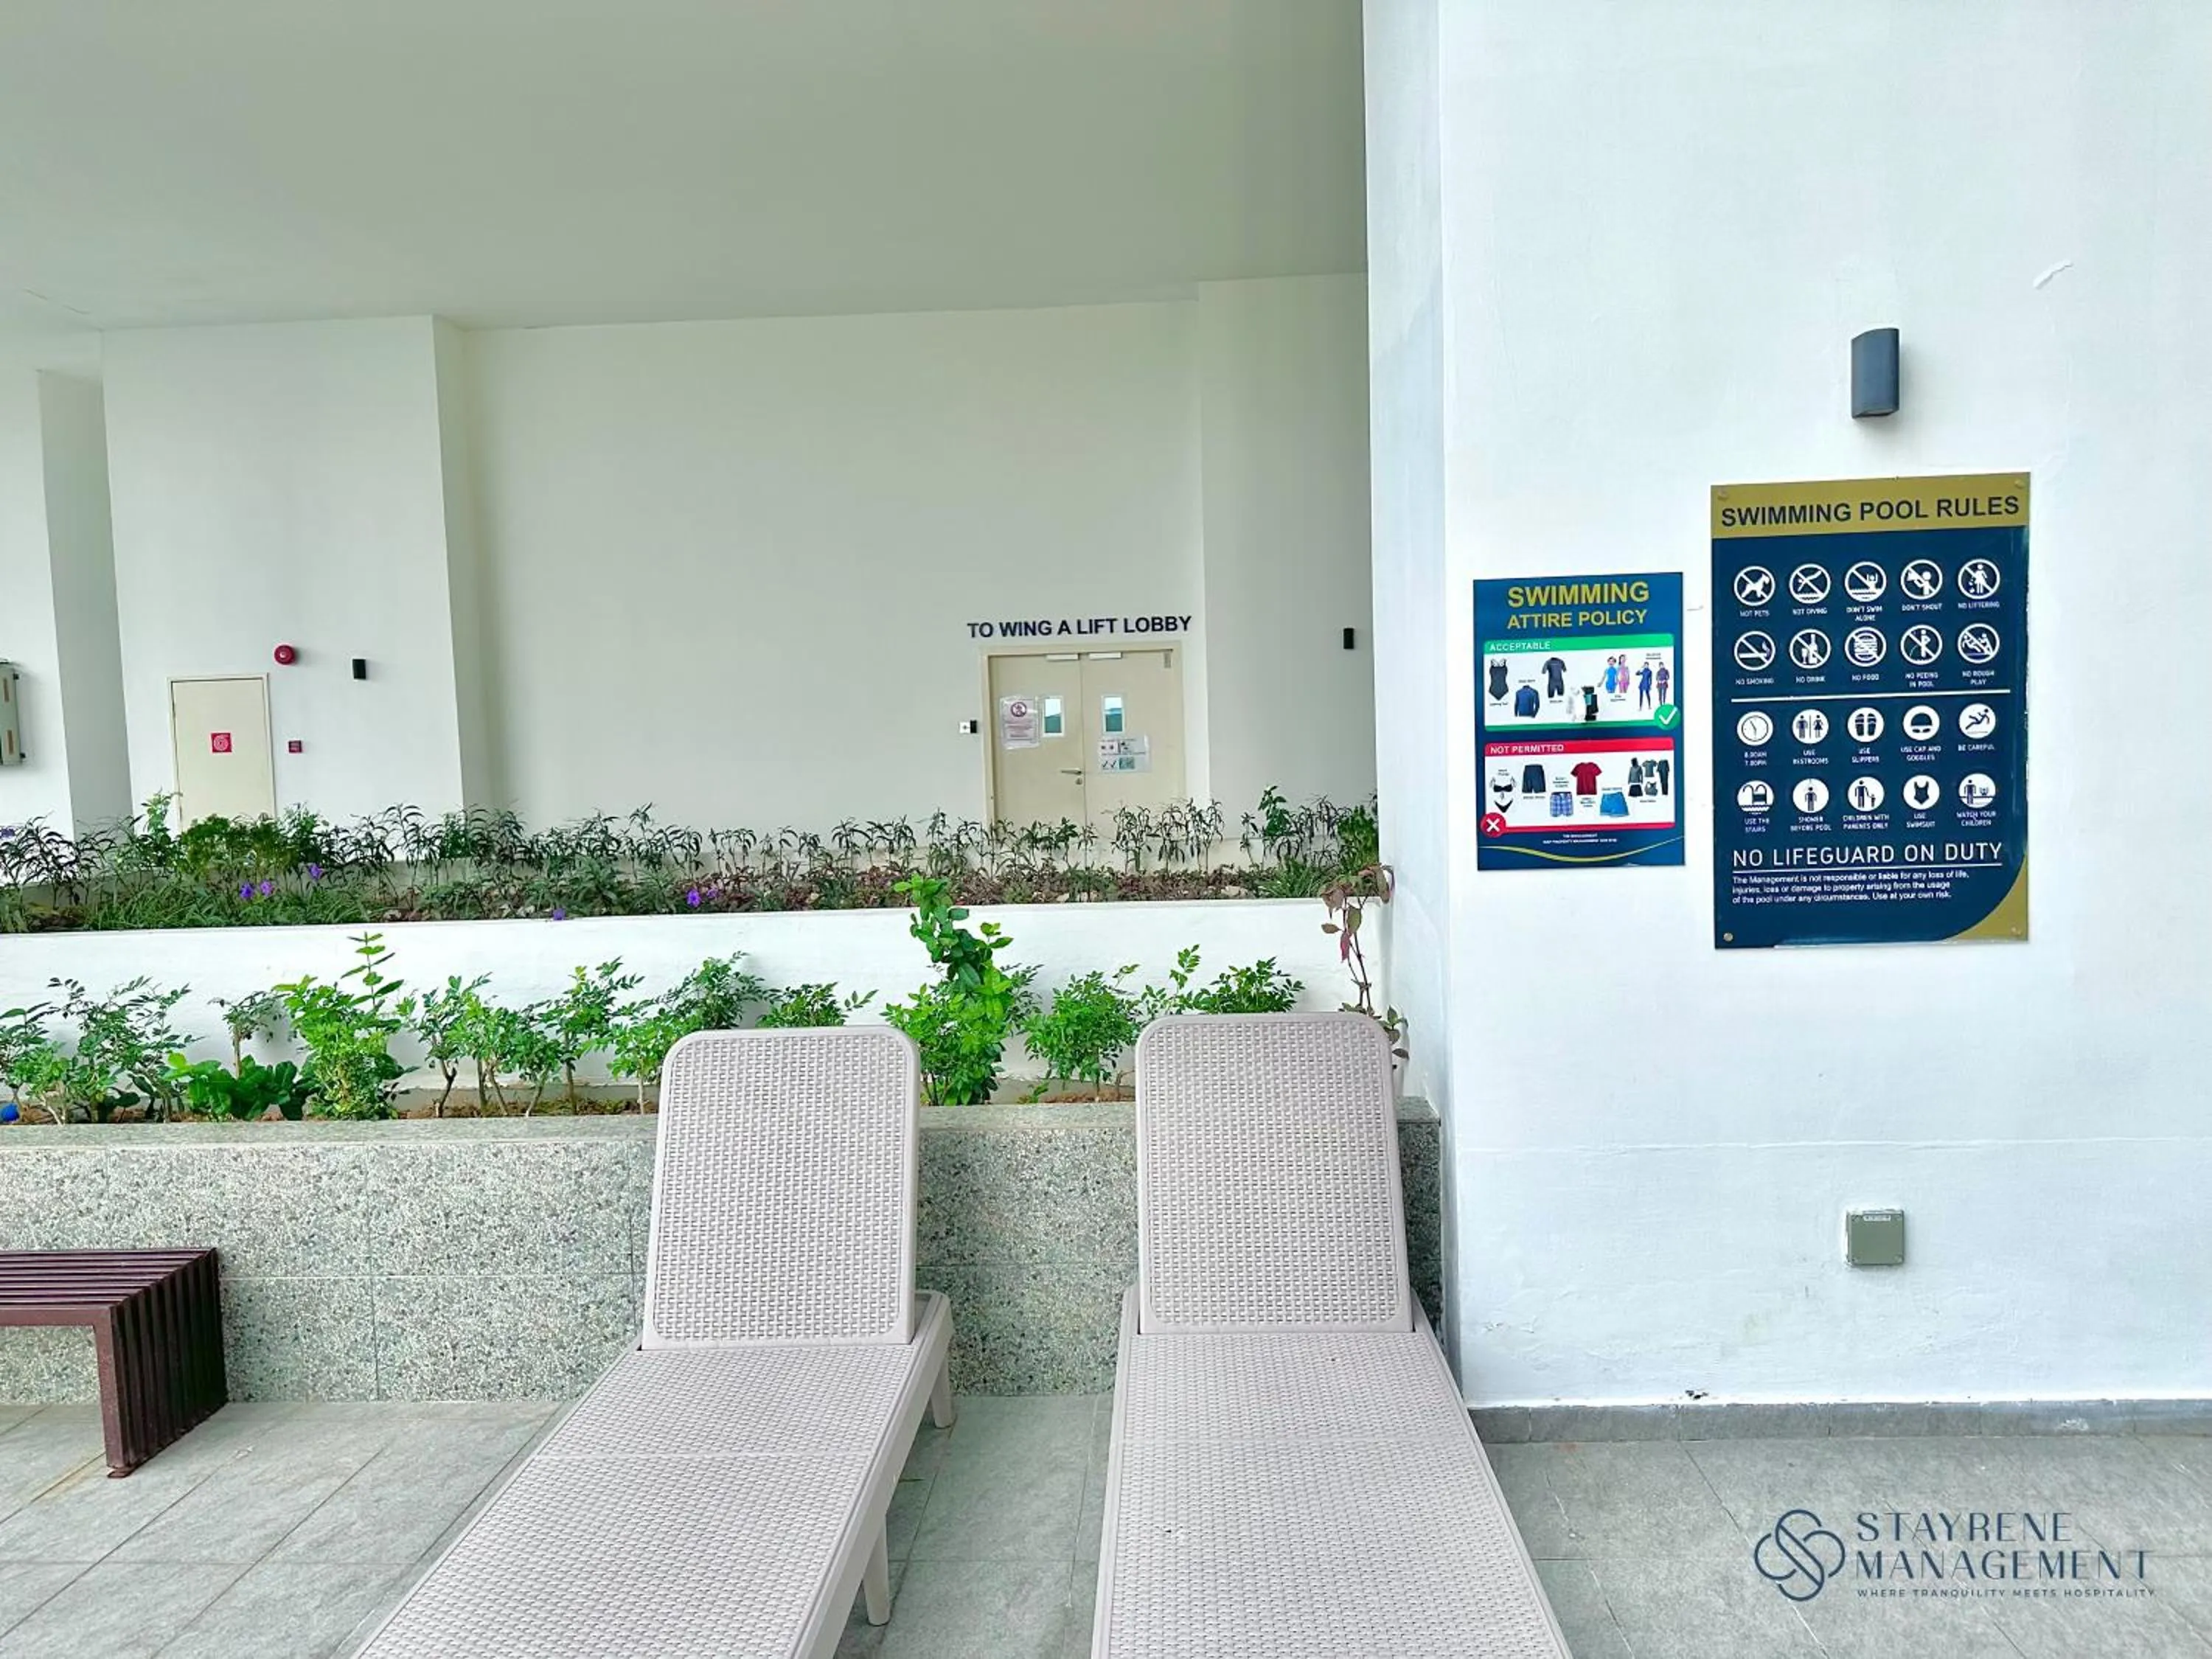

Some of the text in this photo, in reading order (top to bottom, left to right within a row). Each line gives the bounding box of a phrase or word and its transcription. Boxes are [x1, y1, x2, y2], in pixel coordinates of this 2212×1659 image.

[1721, 495, 2019, 527] SWIMMING POOL RULES
[1507, 581, 1650, 608] SWIMMING
[967, 616, 1192, 638] TO WING A LIFT LOBBY
[1507, 609, 1648, 629] ATTIRE POLICY
[1489, 641, 1551, 650] ACCEPTABLE
[1490, 744, 1564, 754] NOT PERMITTED
[1733, 843, 2001, 867] NO LIFEGUARD ON DUTY
[1733, 876, 1747, 884] The
[1749, 875, 1799, 885] Management
[1823, 874, 1867, 883] responsible
[1913, 872, 1927, 880] any
[1946, 870, 1955, 878] of
[1791, 885, 1822, 894] damage
[1832, 883, 1865, 893] property
[1866, 883, 1891, 891] arising
[1927, 882, 1950, 890] usage
[1742, 895, 1754, 903] the
[1756, 895, 1773, 904] pool
[1774, 894, 1797, 902] under
[1798, 895, 1812, 903] any
[1815, 892, 1871, 902] circumstances.
[1873, 891, 1888, 900] Use
[1890, 891, 1897, 900] at
[1899, 892, 1916, 900] your
[1936, 890, 1952, 898] risk.
